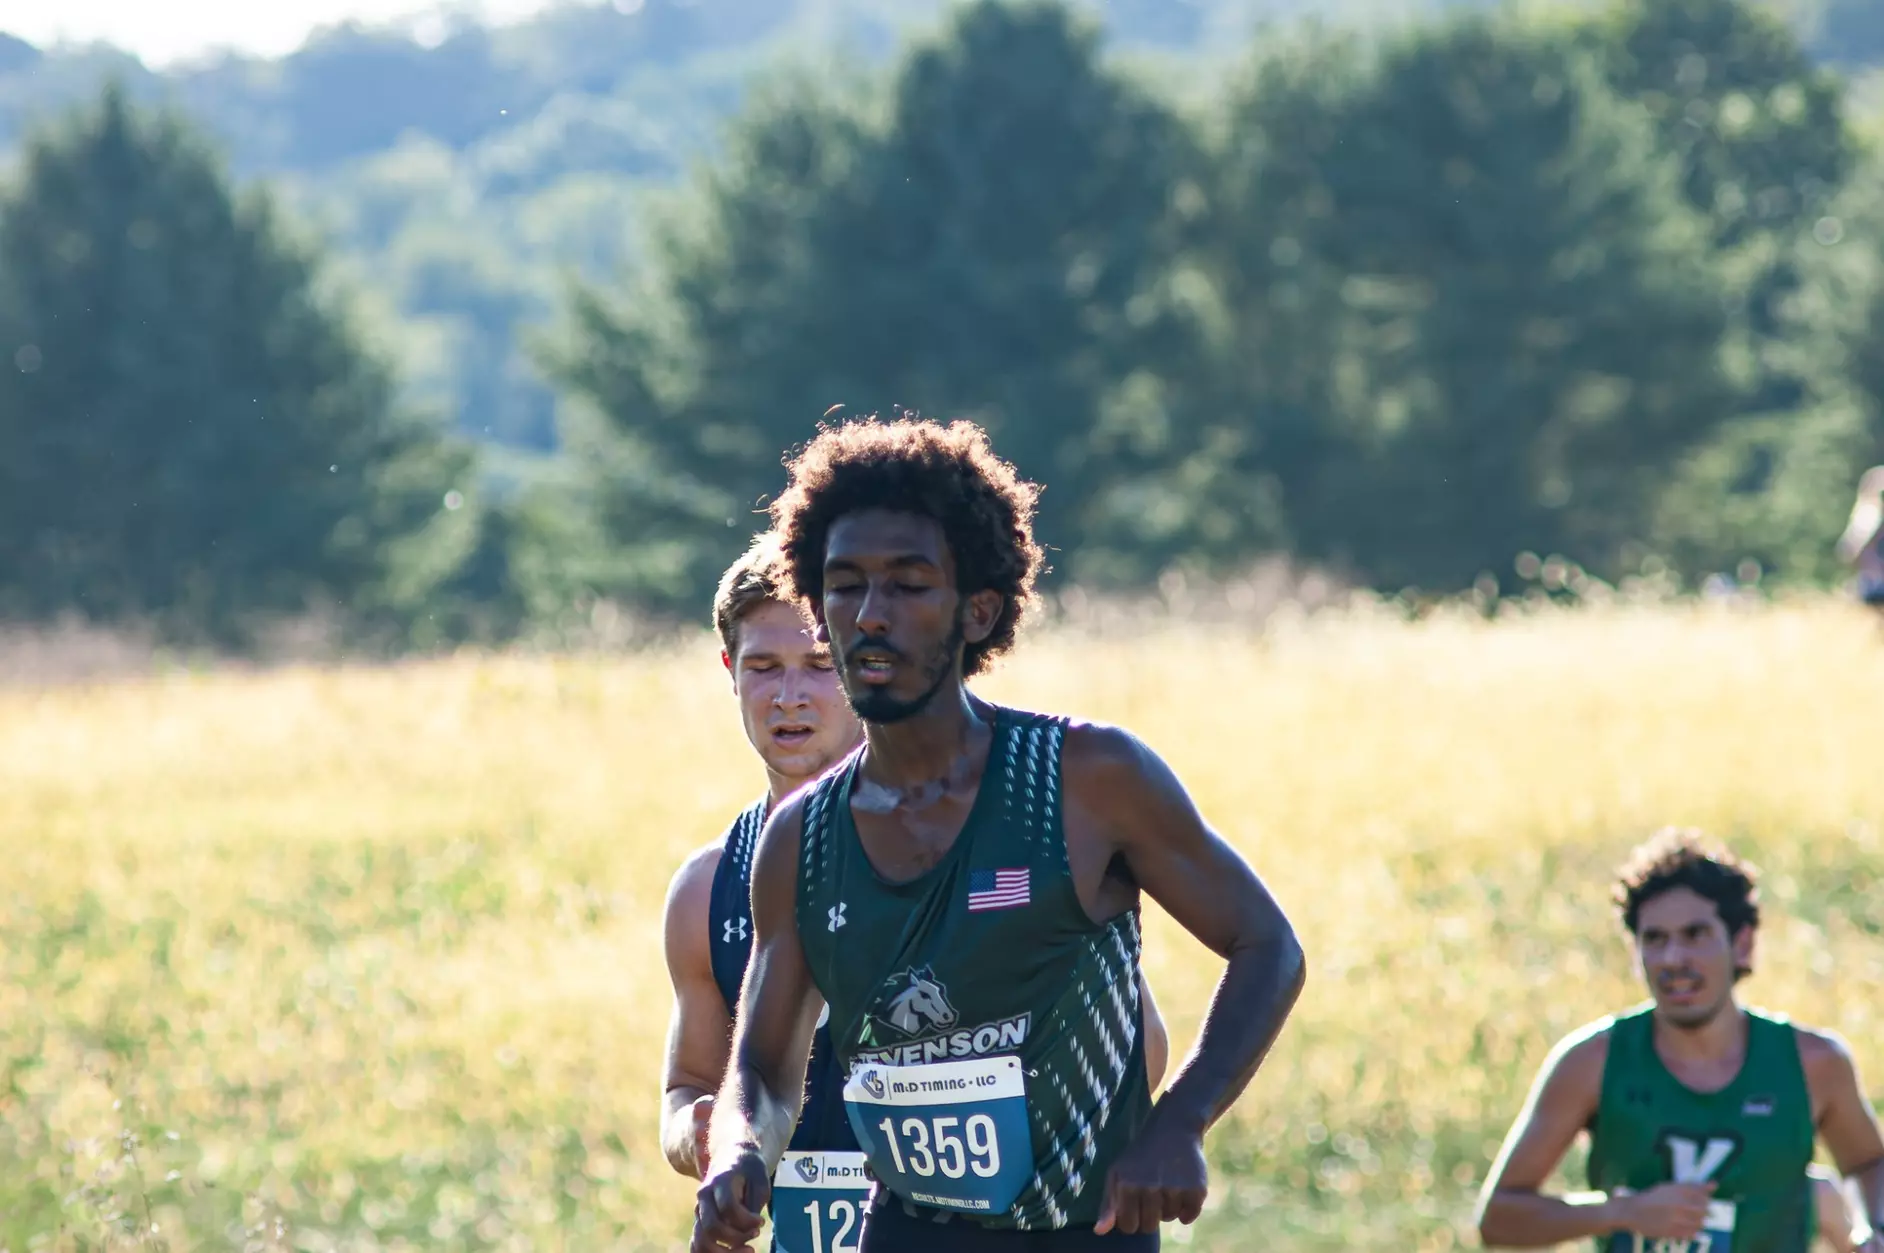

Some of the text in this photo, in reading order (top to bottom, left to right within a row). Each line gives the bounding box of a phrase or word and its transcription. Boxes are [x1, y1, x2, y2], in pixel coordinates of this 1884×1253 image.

[850, 1018, 1027, 1067] EVENSON
[920, 1078, 966, 1092] TIMING
[975, 1075, 997, 1087] LLC
[879, 1114, 1001, 1179] 1359
[803, 1200, 871, 1253] 12
